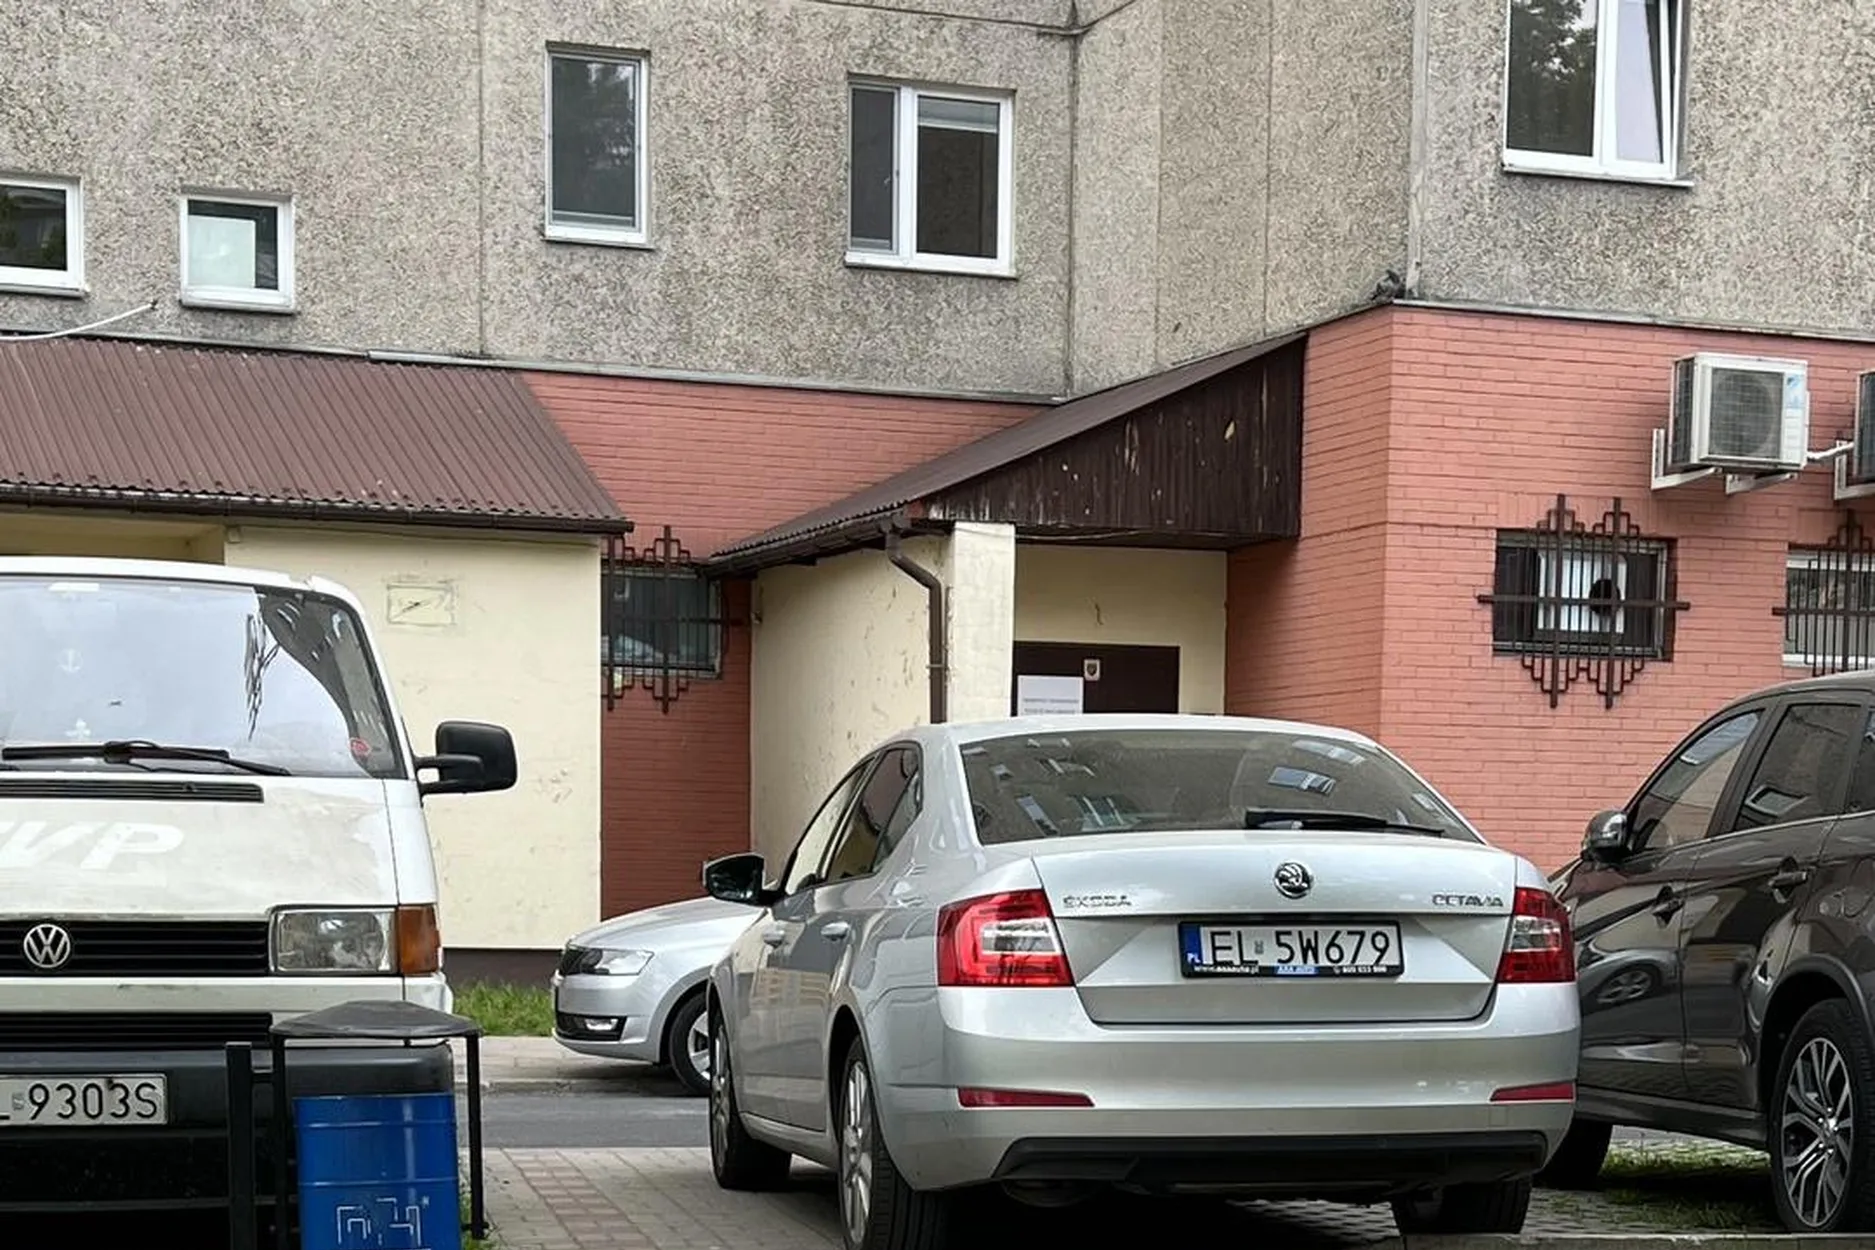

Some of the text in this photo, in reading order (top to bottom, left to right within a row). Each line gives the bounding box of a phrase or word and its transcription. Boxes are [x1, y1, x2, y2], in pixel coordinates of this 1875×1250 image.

[0, 820, 184, 869] VP
[1210, 930, 1390, 966] EL 5W679
[28, 1082, 157, 1120] 9303S
